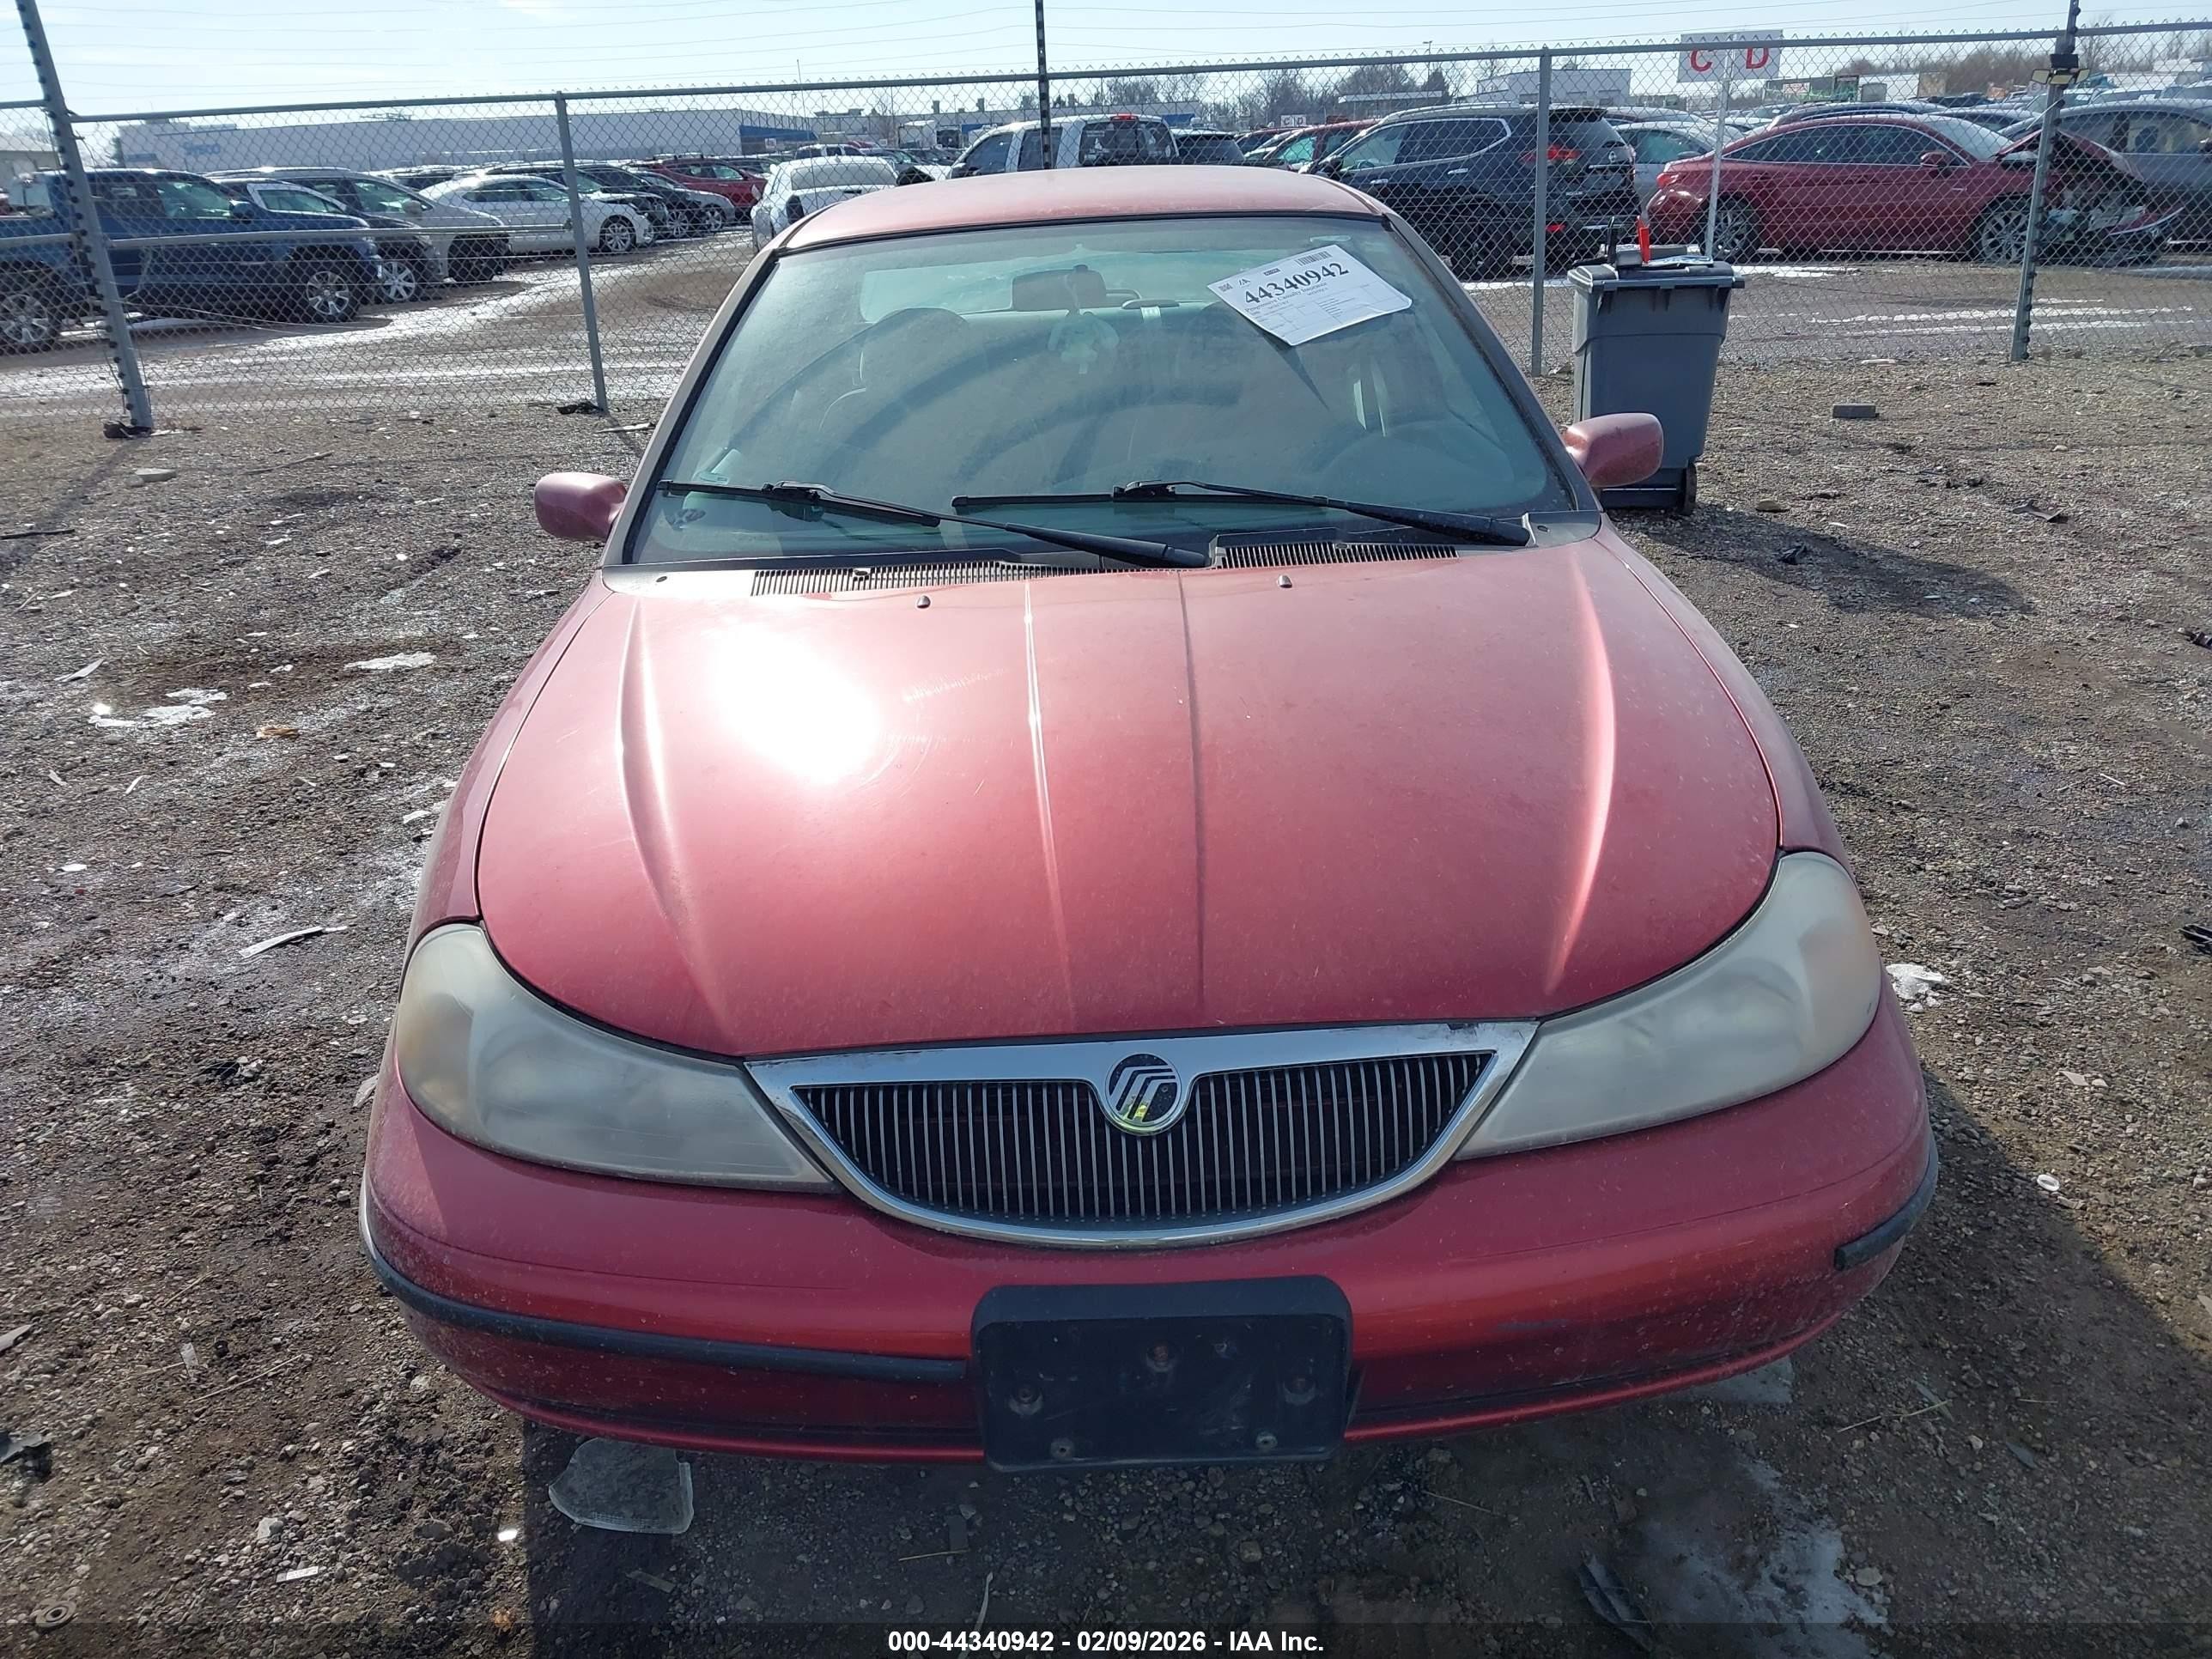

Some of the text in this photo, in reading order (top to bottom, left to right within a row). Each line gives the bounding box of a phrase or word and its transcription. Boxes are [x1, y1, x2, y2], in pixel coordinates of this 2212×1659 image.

[1690, 46, 1770, 72] C D
[1244, 263, 1349, 305] 44340942
